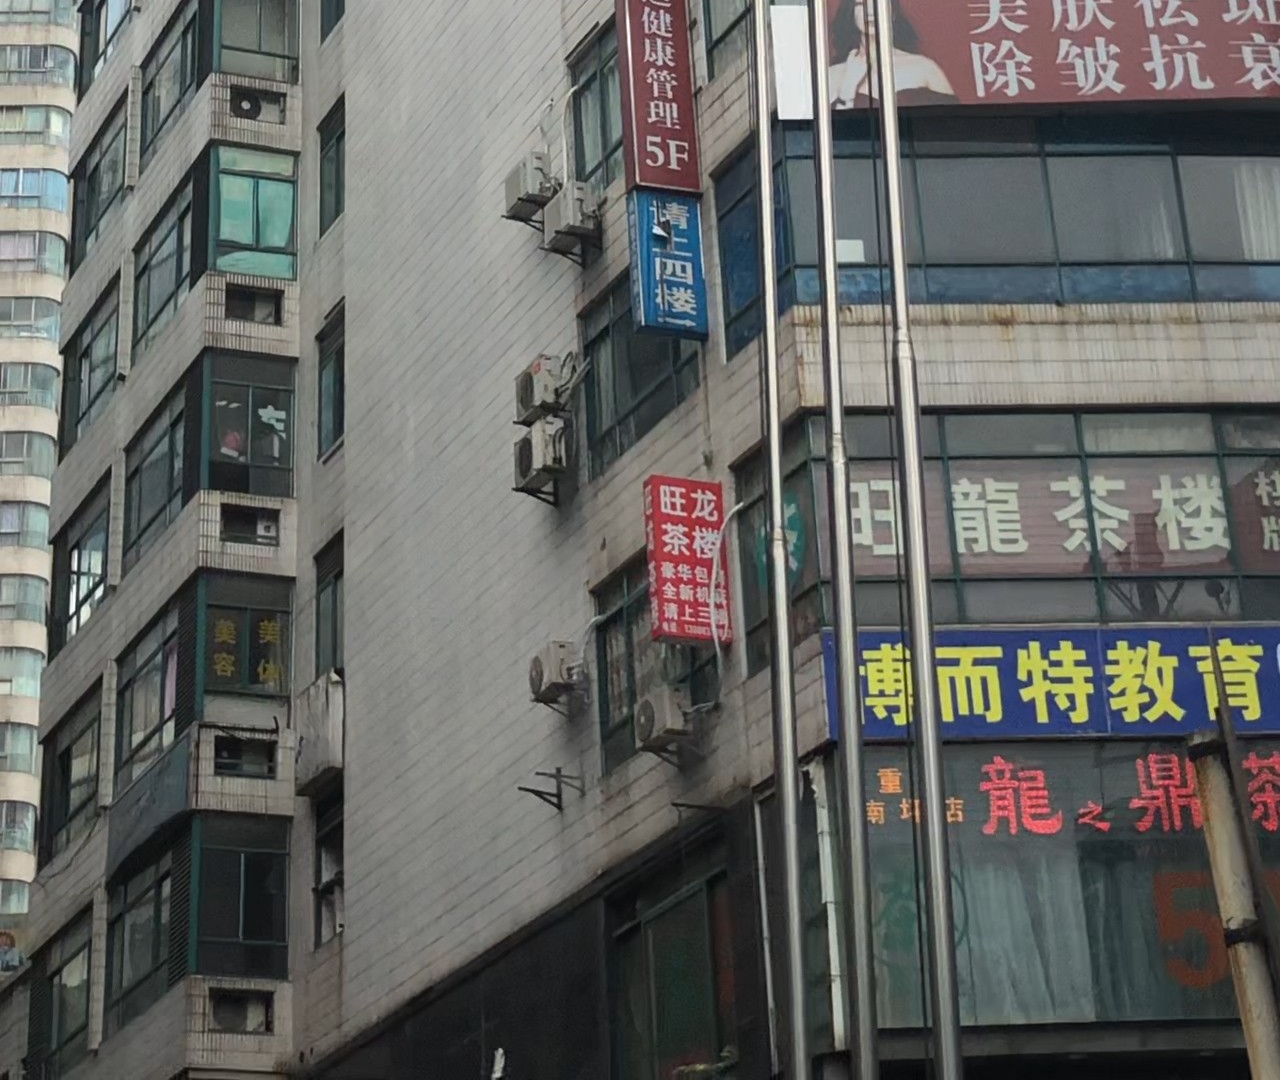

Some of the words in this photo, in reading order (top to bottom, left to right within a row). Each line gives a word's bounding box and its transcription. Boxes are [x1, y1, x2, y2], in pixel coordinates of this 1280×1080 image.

[644, 135, 690, 173] 5F
[659, 484, 719, 522] 旺龙
[661, 522, 721, 560] 茶楼
